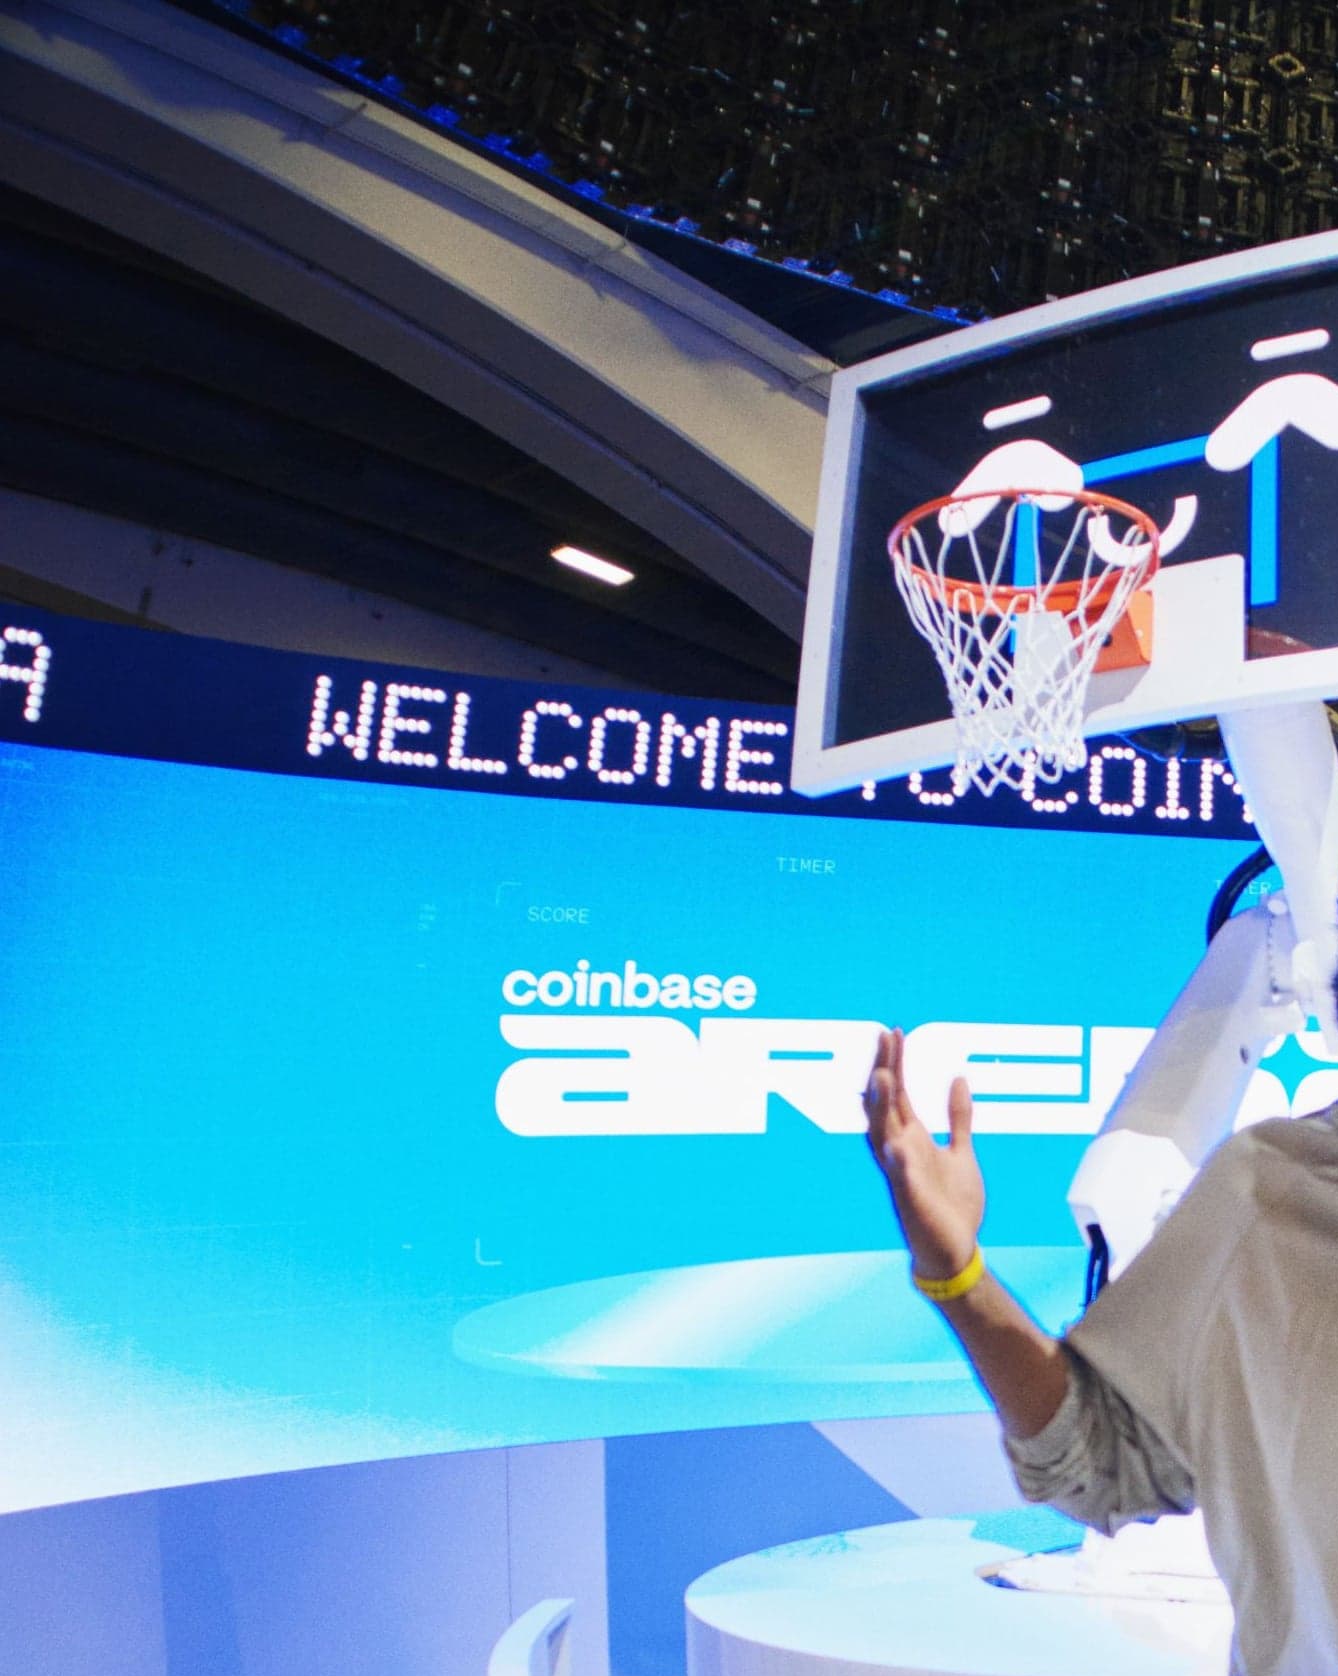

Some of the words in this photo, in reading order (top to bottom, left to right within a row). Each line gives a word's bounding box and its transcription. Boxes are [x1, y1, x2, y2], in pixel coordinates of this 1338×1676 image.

[307, 675, 788, 796] WELCOME
[776, 857, 836, 875] TIMER
[1213, 879, 1272, 896] TER
[527, 906, 591, 924] SCORE
[501, 959, 757, 1011] coinbase
